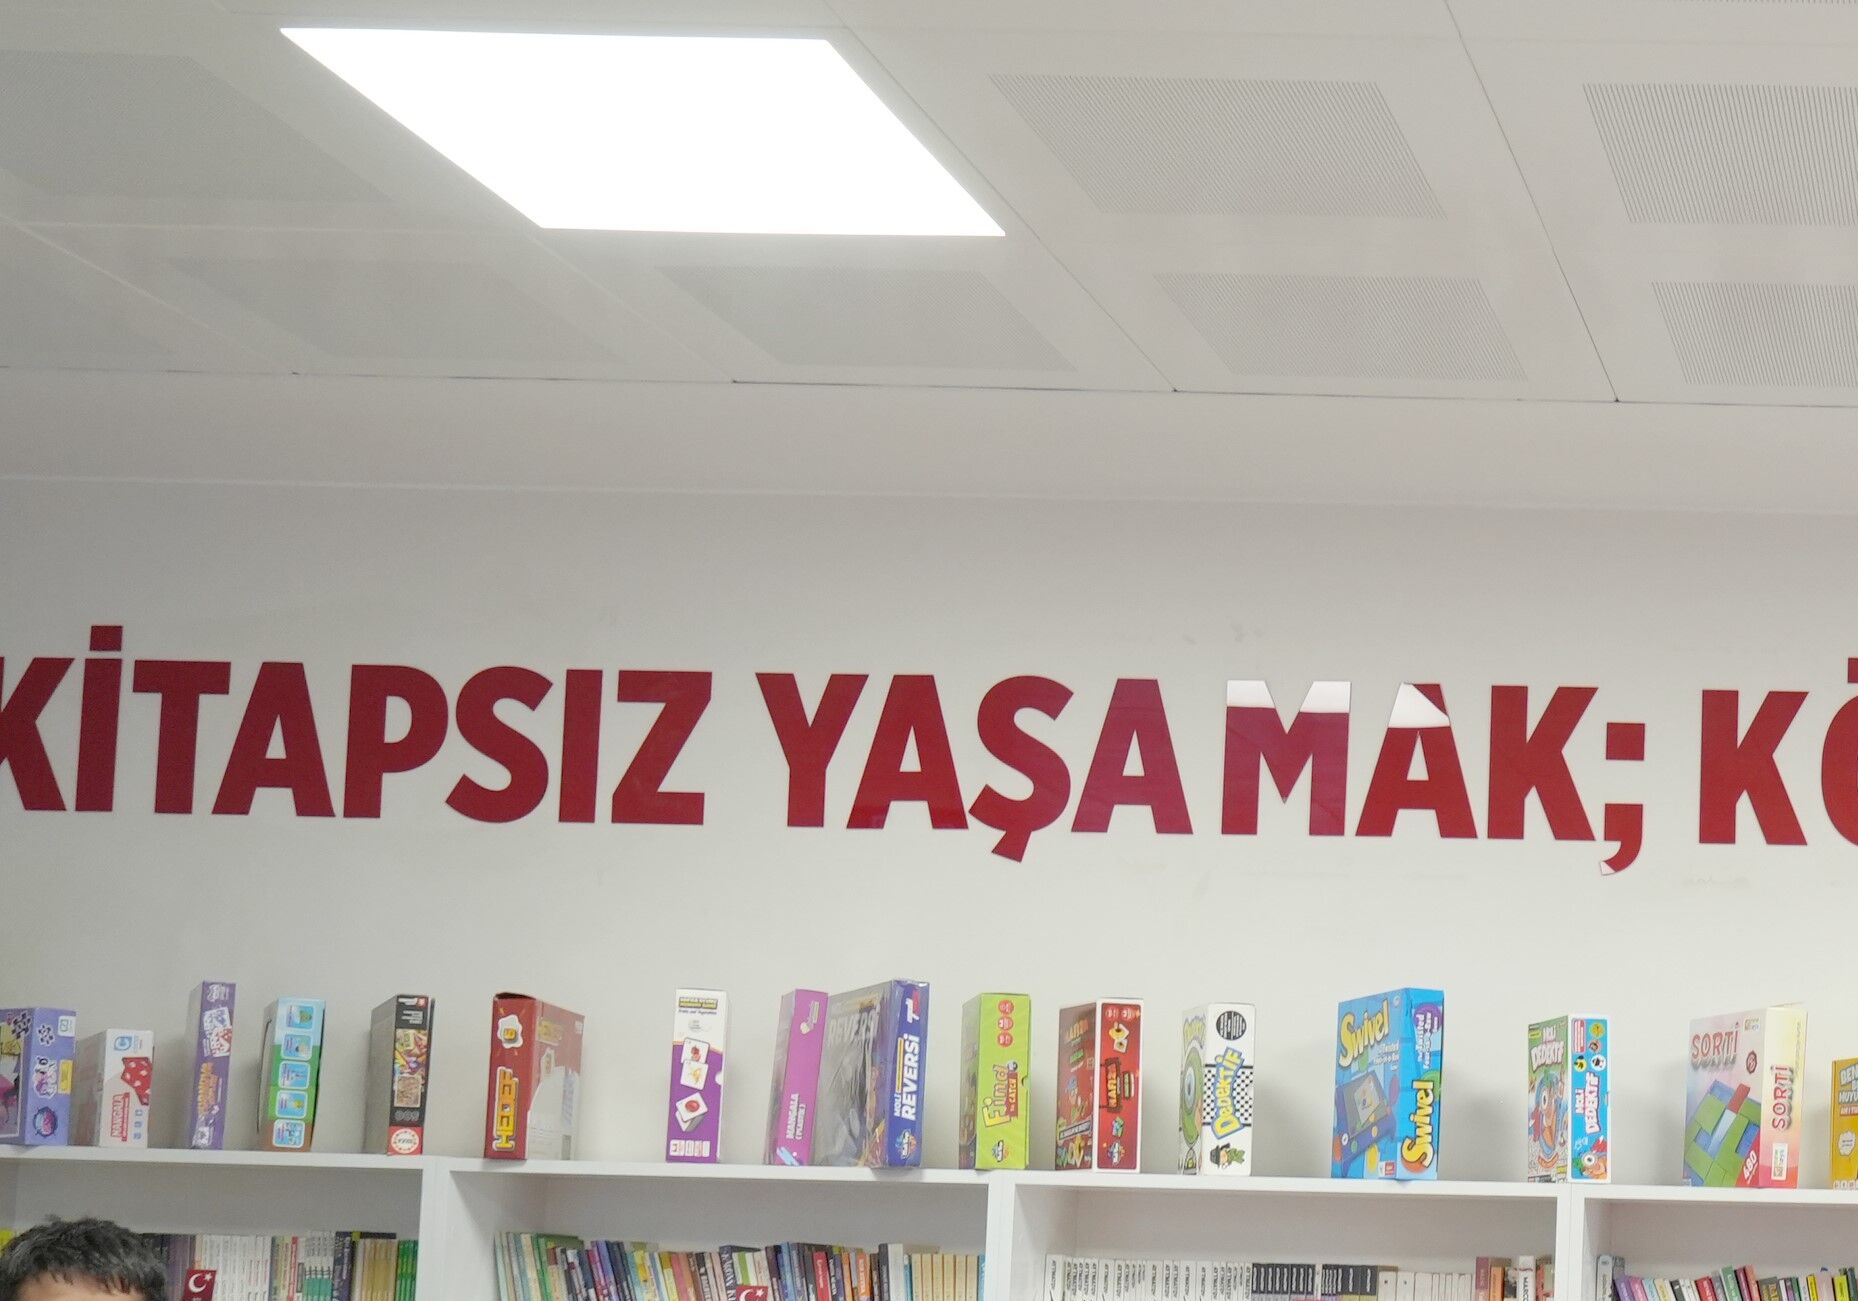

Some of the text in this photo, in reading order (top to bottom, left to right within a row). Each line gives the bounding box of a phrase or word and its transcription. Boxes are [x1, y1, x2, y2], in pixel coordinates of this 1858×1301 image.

[0, 625, 714, 826] KİTAPSIZ
[1338, 999, 1389, 1068] Swivel
[1691, 1022, 1739, 1060] SORTİ
[1402, 1080, 1434, 1168] Swivel
[1772, 1065, 1789, 1130] SORTİ
